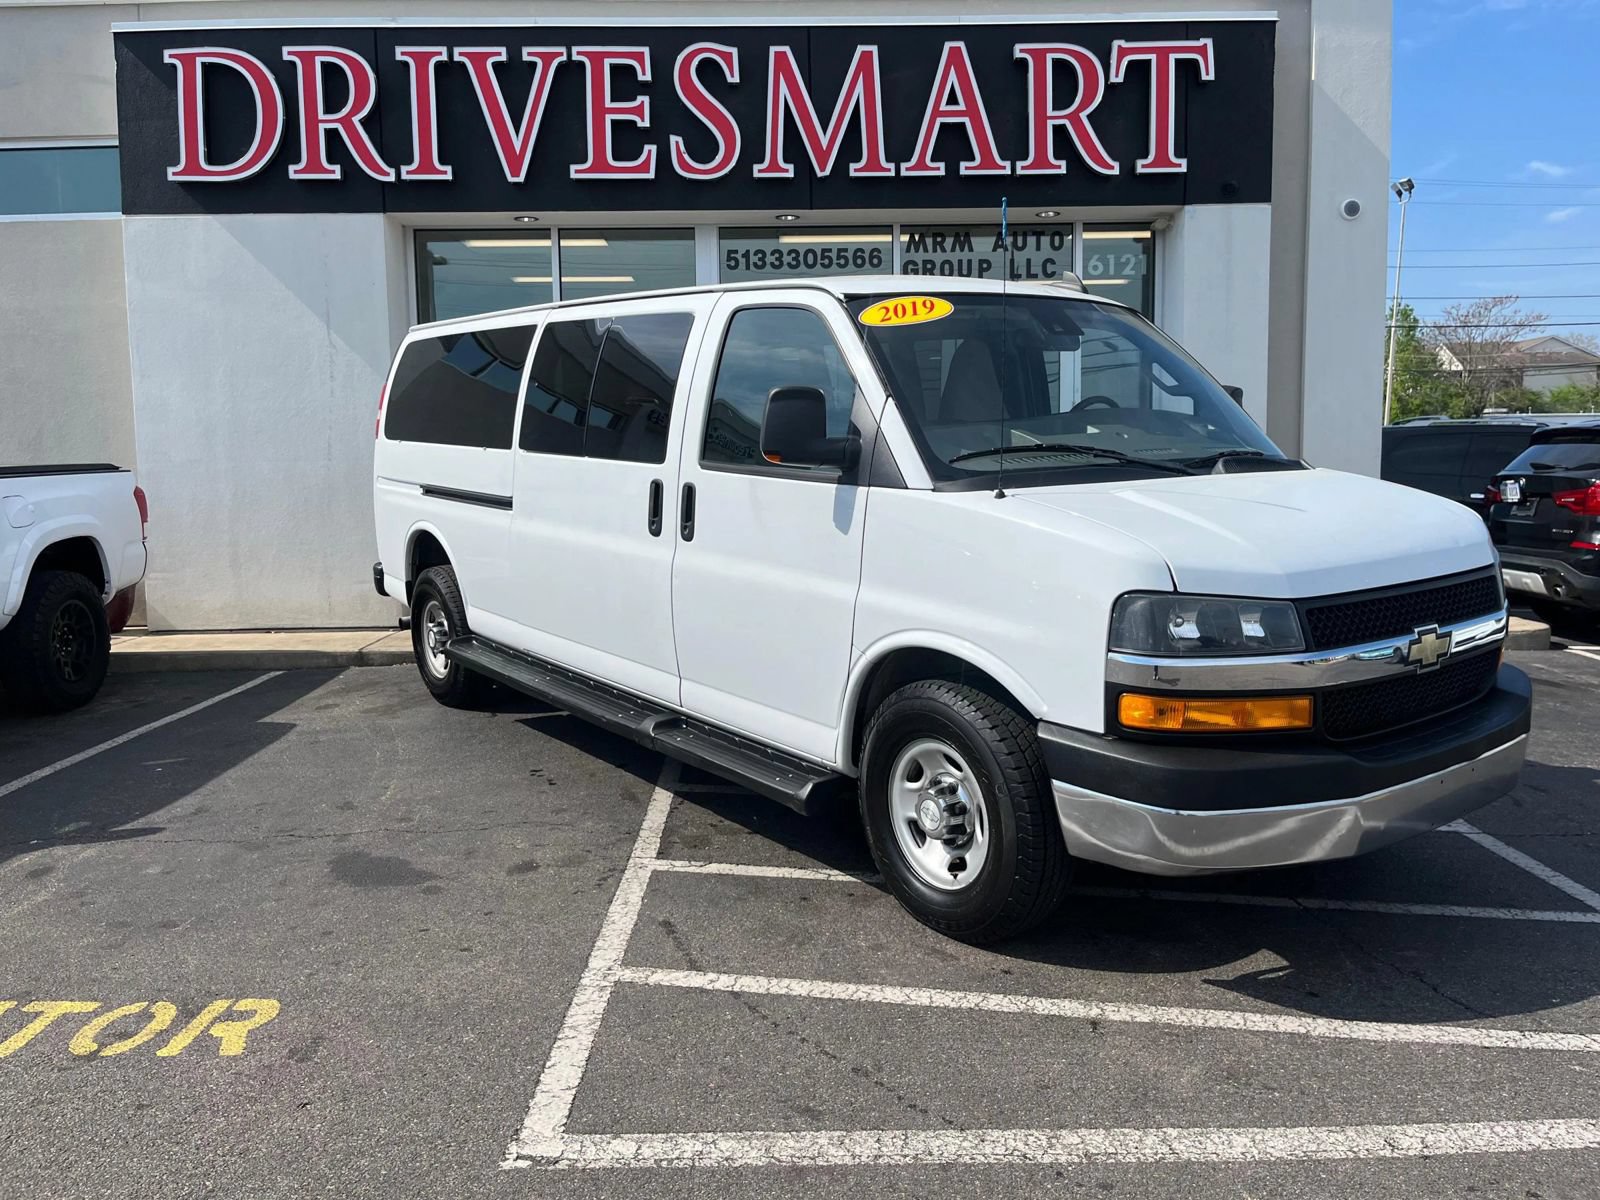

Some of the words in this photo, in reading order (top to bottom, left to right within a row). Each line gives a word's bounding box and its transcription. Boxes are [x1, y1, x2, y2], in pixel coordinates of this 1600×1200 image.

[163, 38, 1215, 183] DRIVESMART
[905, 232, 974, 253] MRM
[992, 231, 1065, 252] AUTO
[726, 247, 883, 271] 5133305566
[903, 258, 992, 279] GROUP
[1009, 257, 1057, 279] LLC
[879, 298, 935, 323] 2019
[0, 998, 281, 1057] TOR
